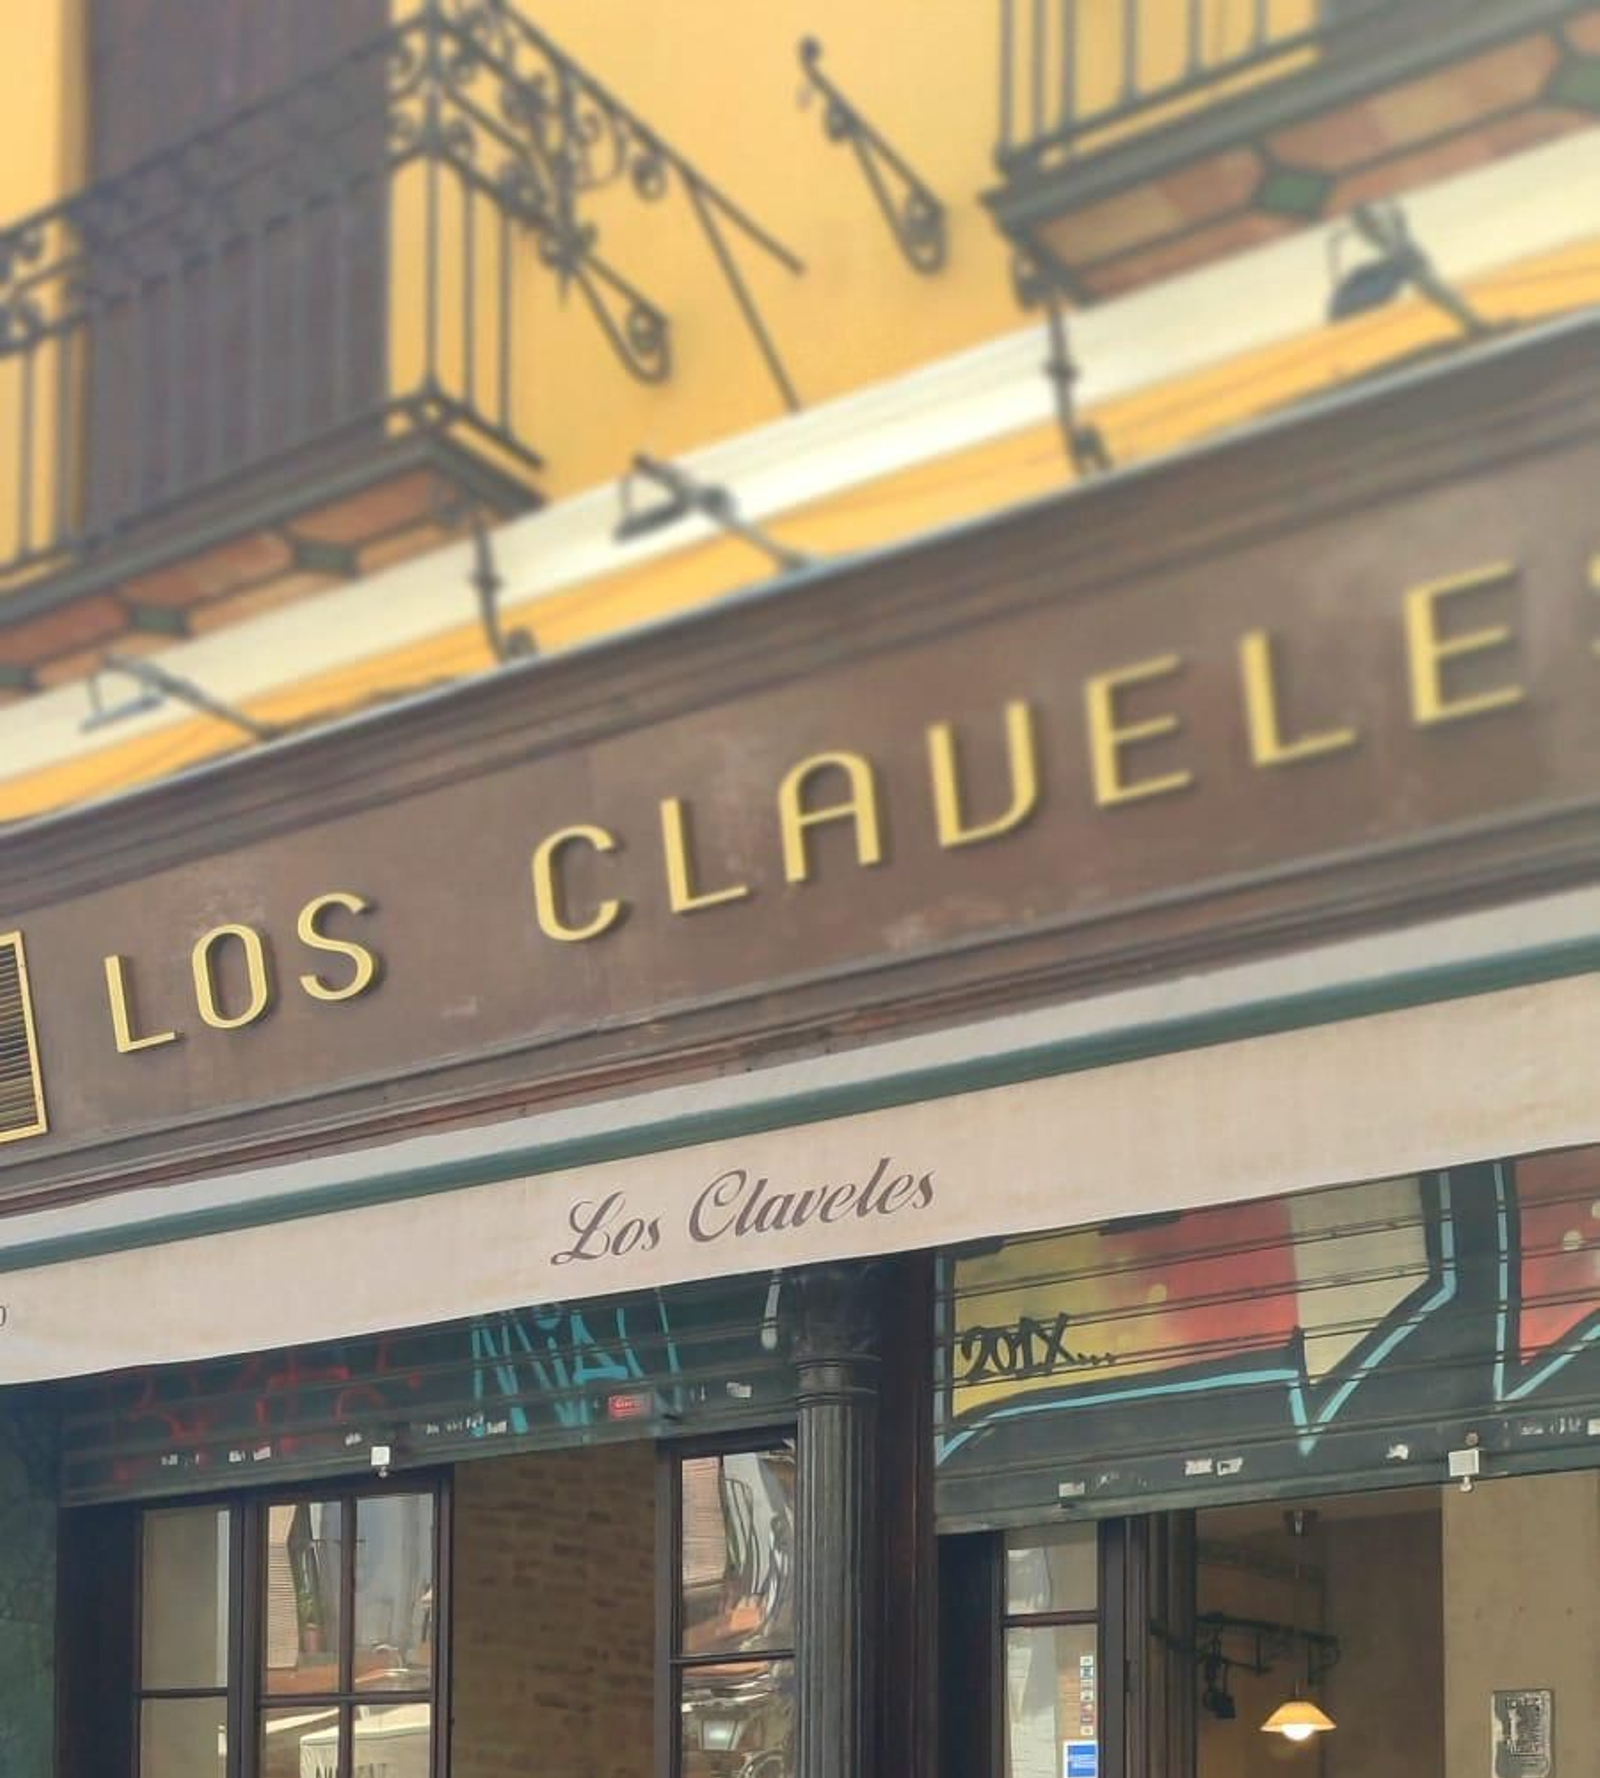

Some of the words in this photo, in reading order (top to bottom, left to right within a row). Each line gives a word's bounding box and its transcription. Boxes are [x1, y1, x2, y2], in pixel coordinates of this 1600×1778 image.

[103, 892, 379, 1054] LOS
[531, 553, 1600, 942] CLAVELE
[550, 1190, 662, 1266] Los
[689, 1157, 938, 1243] Claveles
